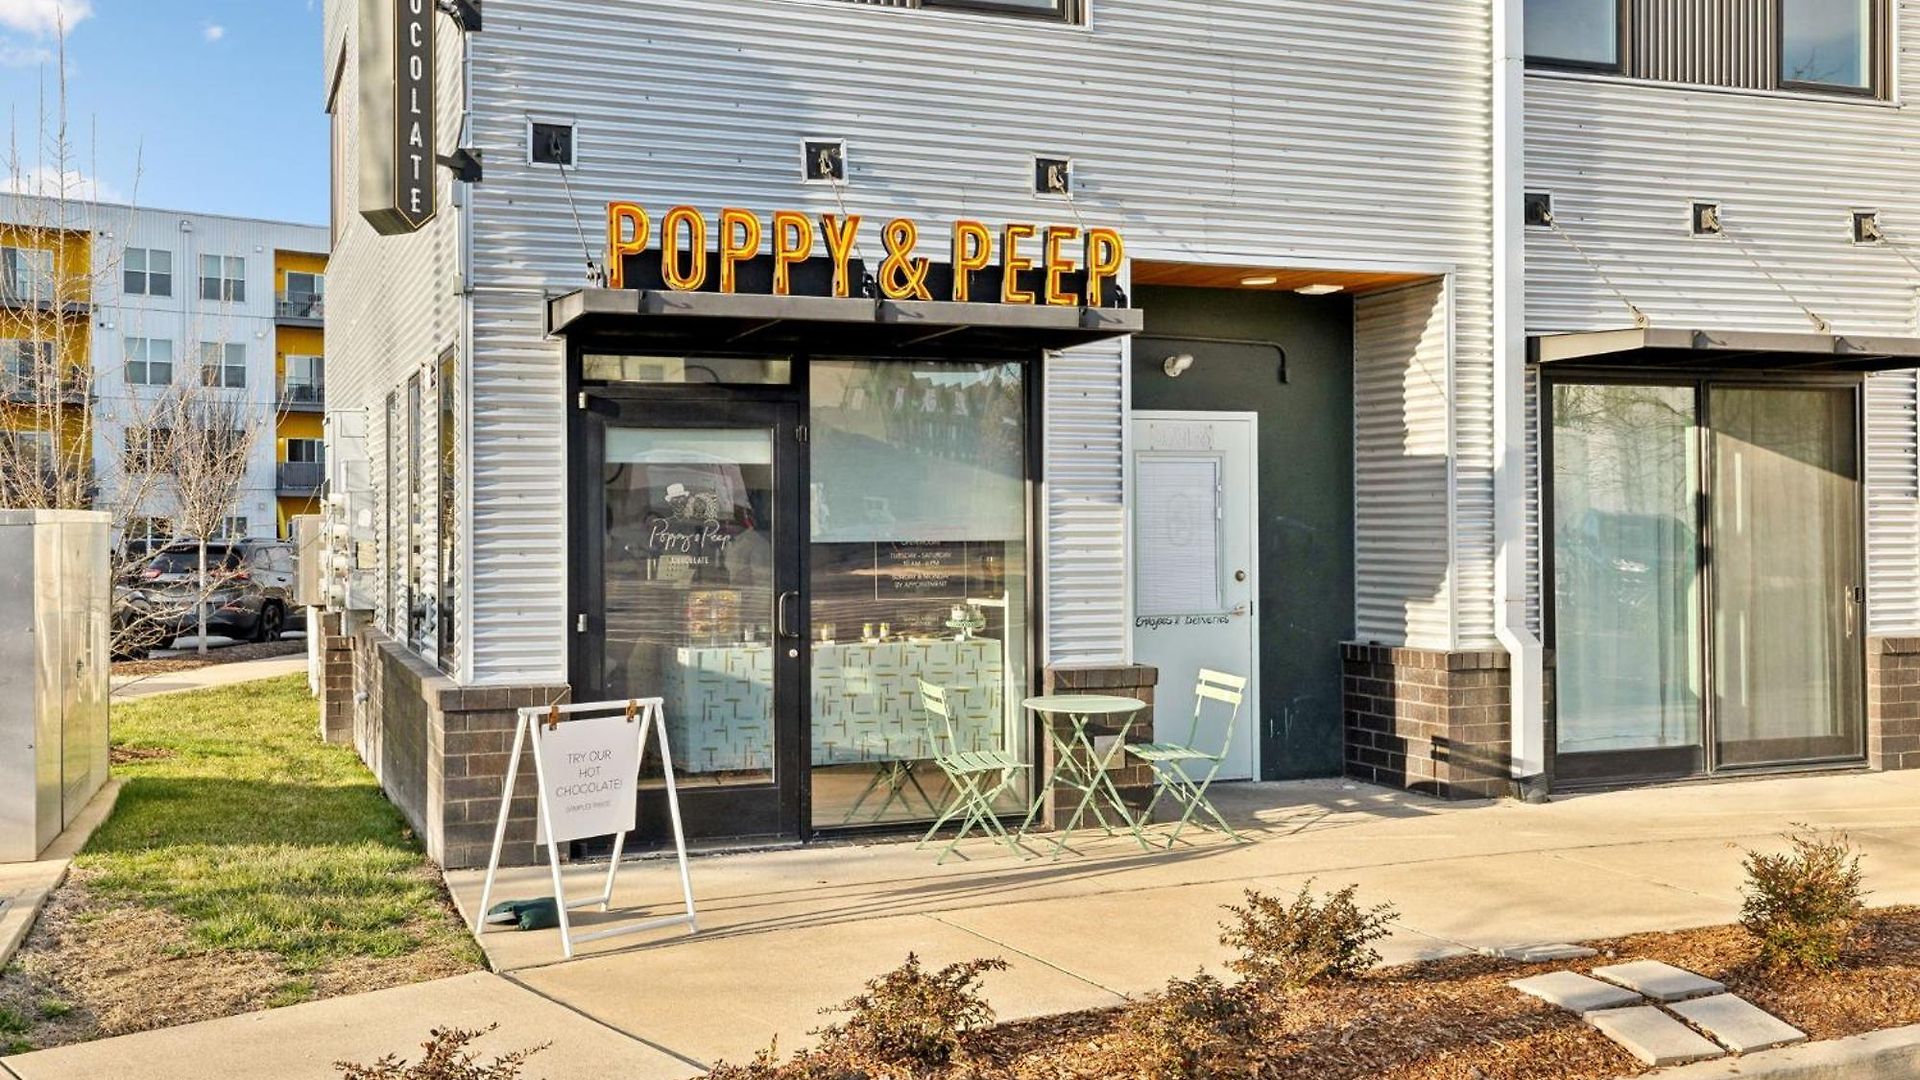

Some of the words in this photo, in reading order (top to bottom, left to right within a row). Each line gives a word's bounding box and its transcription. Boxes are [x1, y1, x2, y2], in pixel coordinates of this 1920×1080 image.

[606, 202, 862, 298] POPPY
[878, 218, 934, 301] &
[951, 219, 1124, 306] PEEP
[649, 518, 694, 552] Poppy
[701, 519, 732, 550] Peep
[567, 752, 586, 765] TRY
[588, 749, 612, 763] OUR
[579, 766, 602, 779] HOT
[555, 779, 623, 798] CHOCOLATE!
